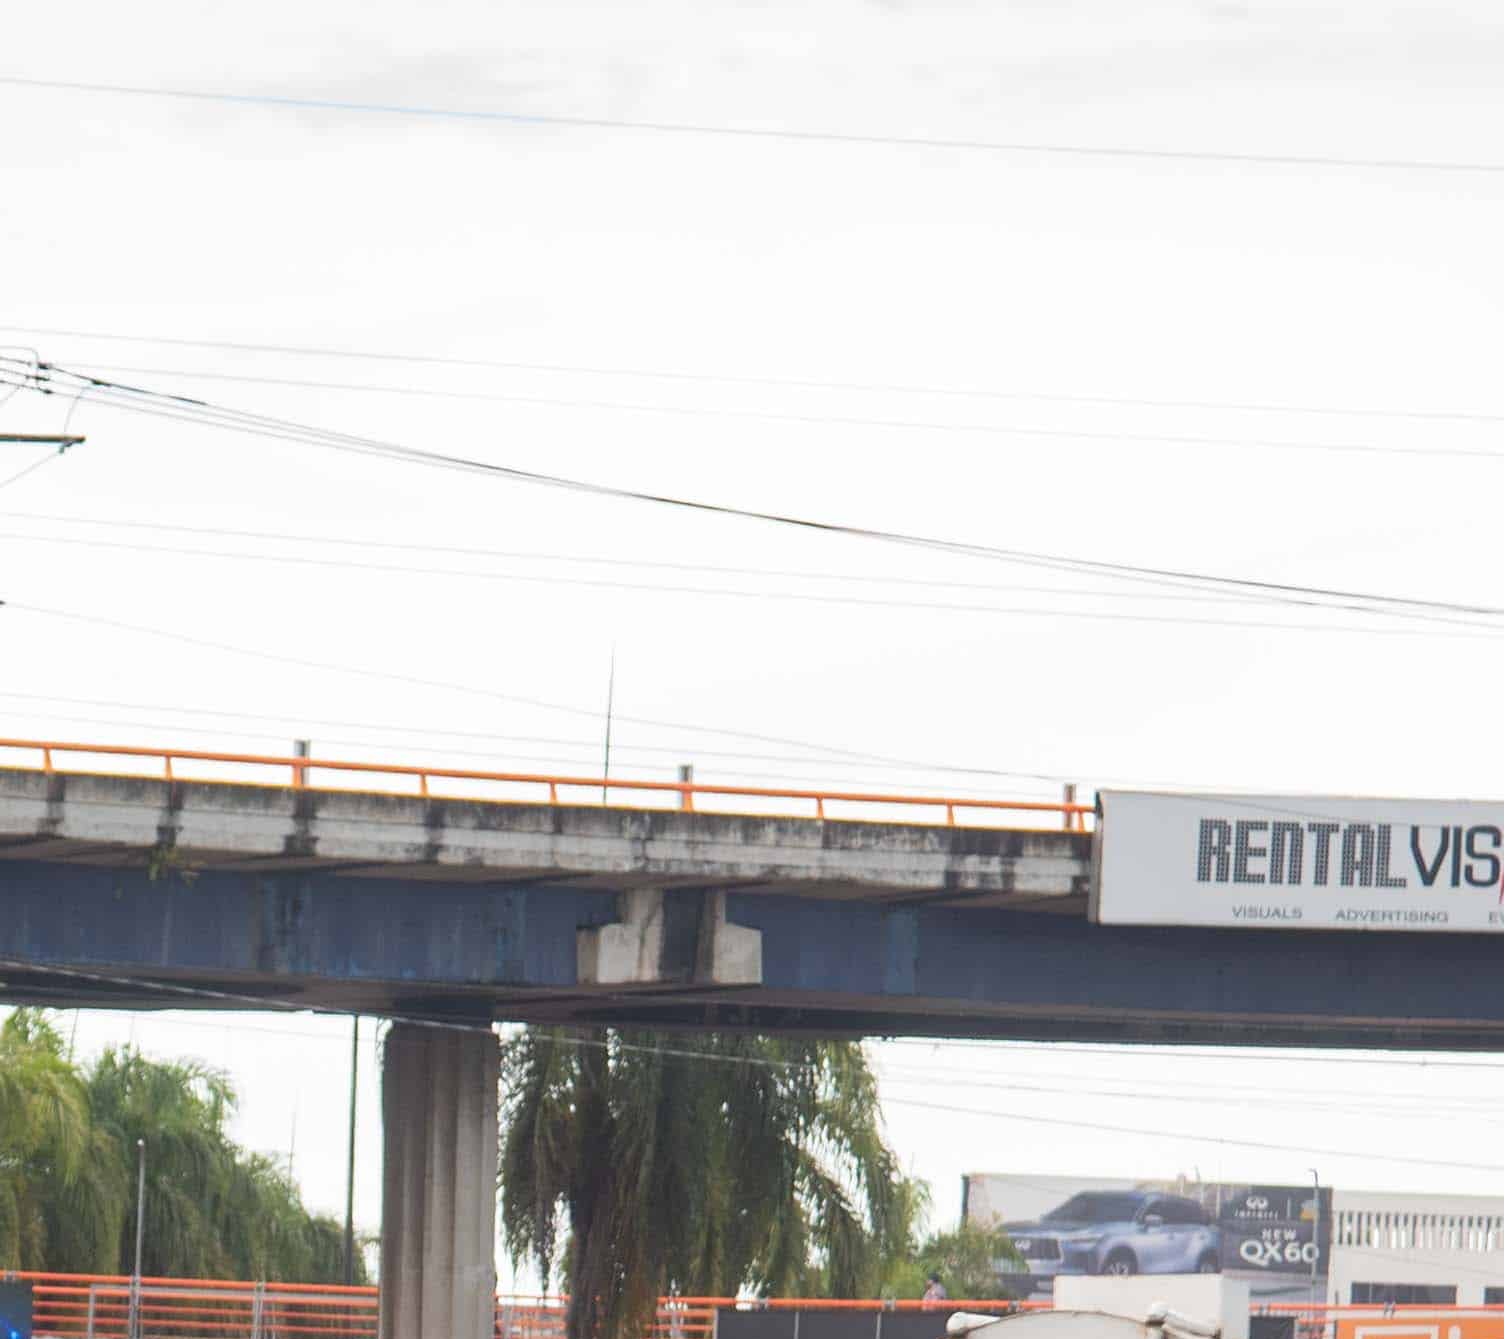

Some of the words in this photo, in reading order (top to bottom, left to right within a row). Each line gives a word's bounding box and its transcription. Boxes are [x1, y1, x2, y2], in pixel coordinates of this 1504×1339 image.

[1231, 907, 1303, 920] VISUALS
[1335, 909, 1449, 924] ADVERTISING
[1262, 1228, 1296, 1241] NEW
[1239, 1239, 1320, 1268] QX60
